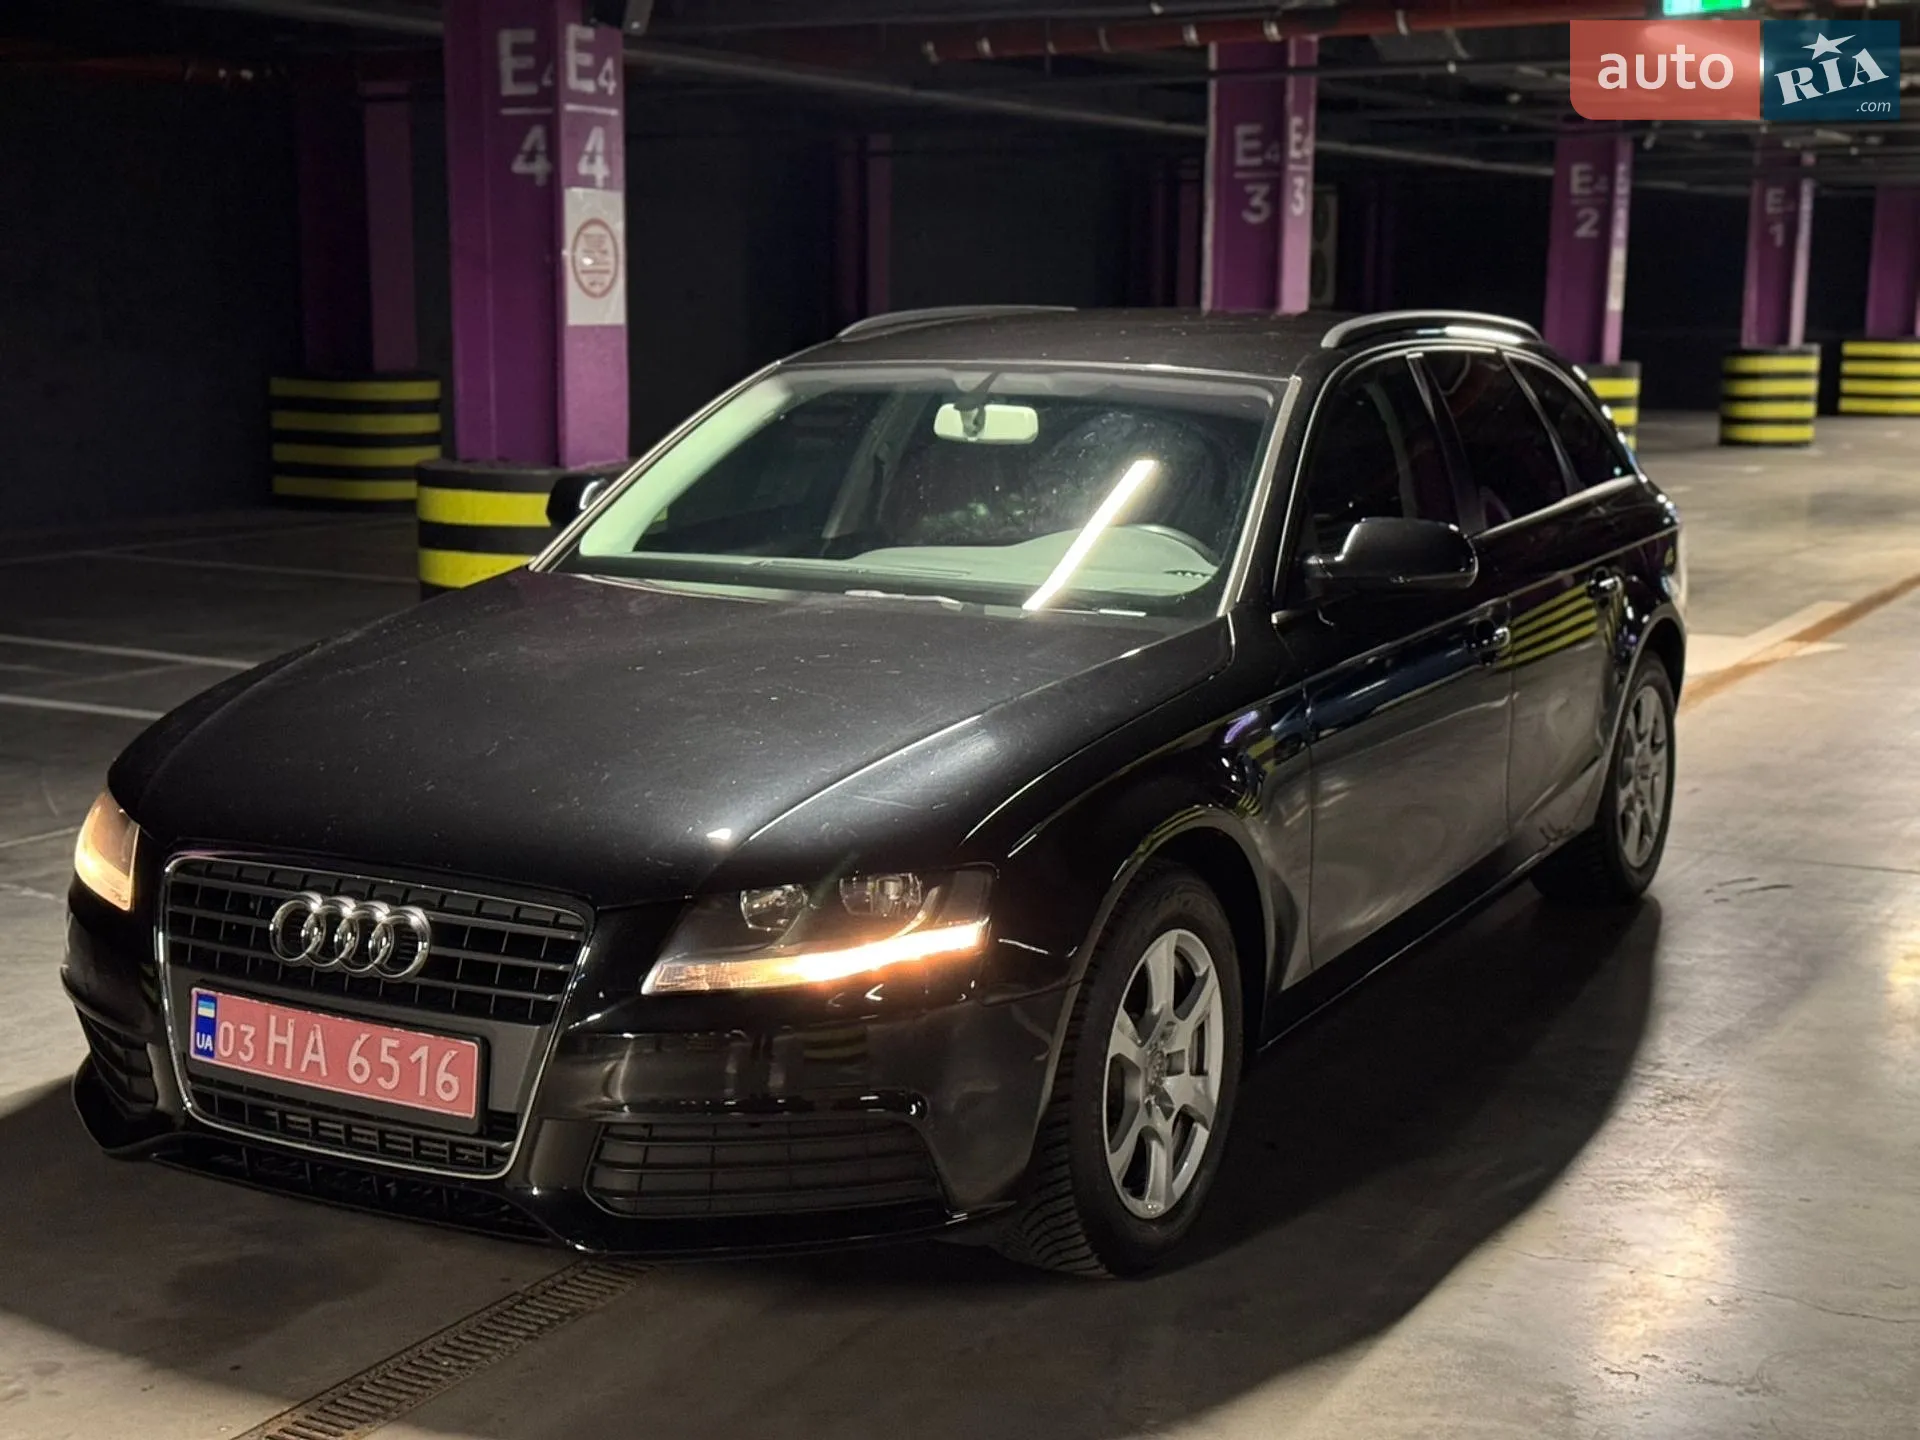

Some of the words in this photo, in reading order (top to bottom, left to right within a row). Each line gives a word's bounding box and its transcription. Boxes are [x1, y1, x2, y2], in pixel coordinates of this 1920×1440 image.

[566, 23, 617, 97] E4
[511, 124, 553, 187] 4
[578, 126, 610, 188] 4
[1242, 184, 1271, 223] 3
[1291, 176, 1304, 216] 3
[1574, 207, 1600, 238] 2
[1769, 222, 1784, 247] 1
[196, 1032, 213, 1051] UA
[219, 1021, 254, 1062] 03
[266, 1015, 328, 1077] HA
[348, 1033, 460, 1101] 6516
